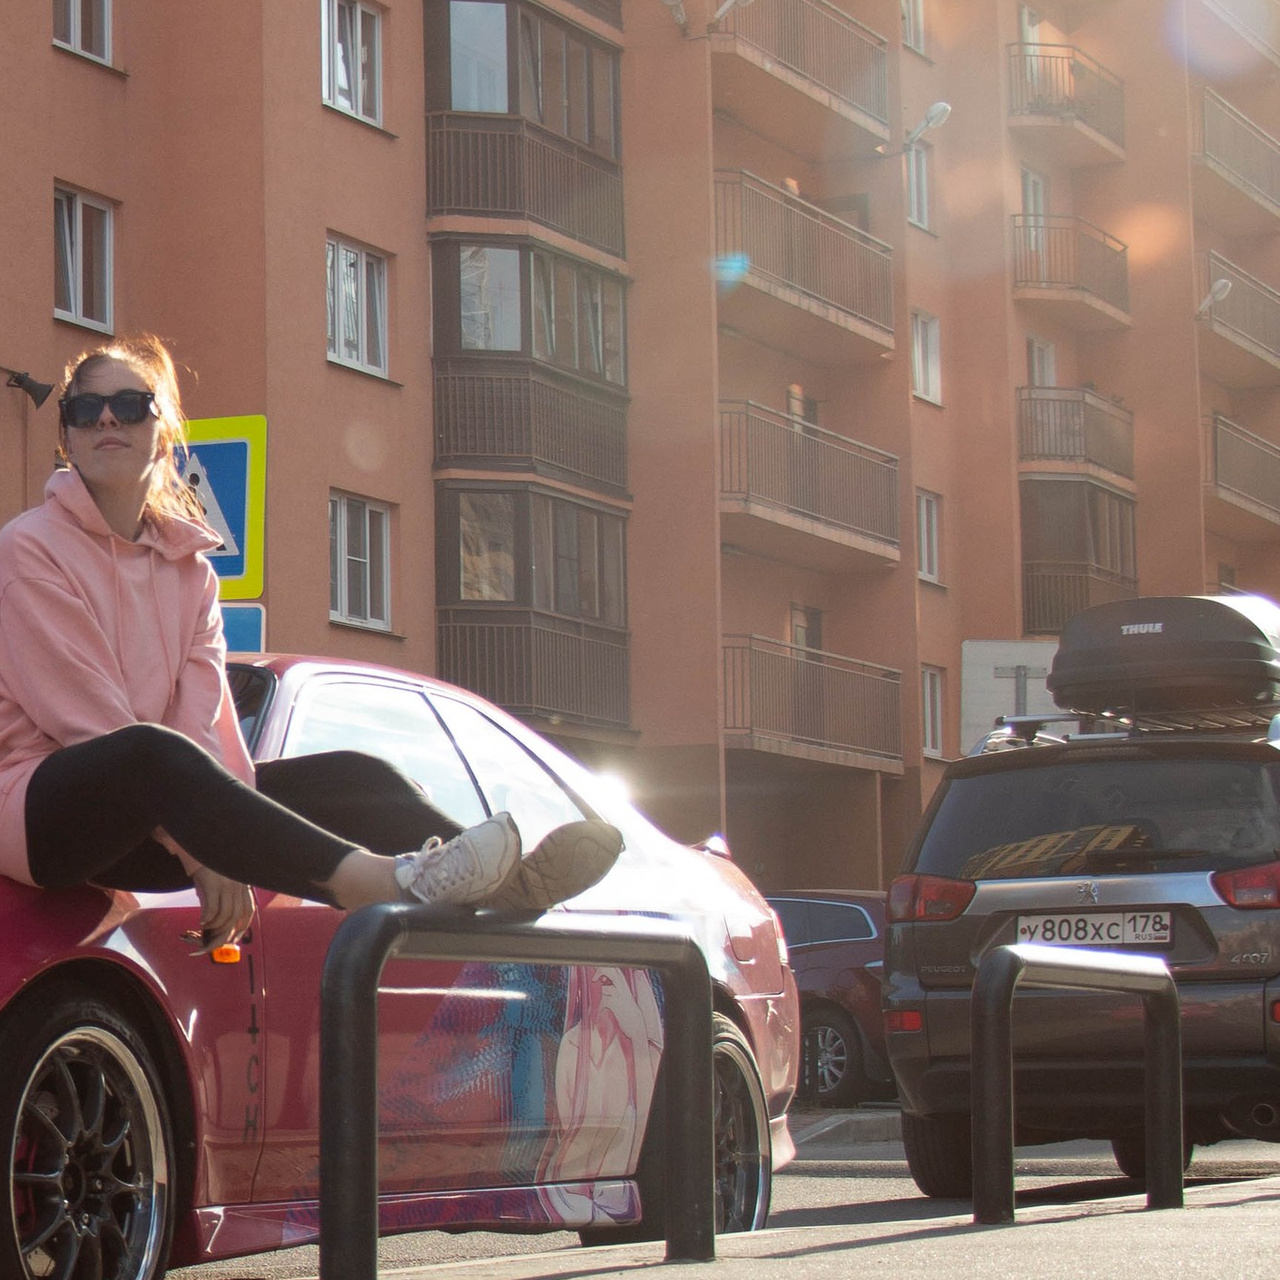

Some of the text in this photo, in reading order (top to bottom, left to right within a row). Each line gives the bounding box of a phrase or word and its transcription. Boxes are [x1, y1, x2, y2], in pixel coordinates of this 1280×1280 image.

[1120, 622, 1163, 635] THULE
[1127, 914, 1163, 933] 178
[1135, 933, 1153, 941] RUS
[920, 965, 967, 973] PEUGEOT
